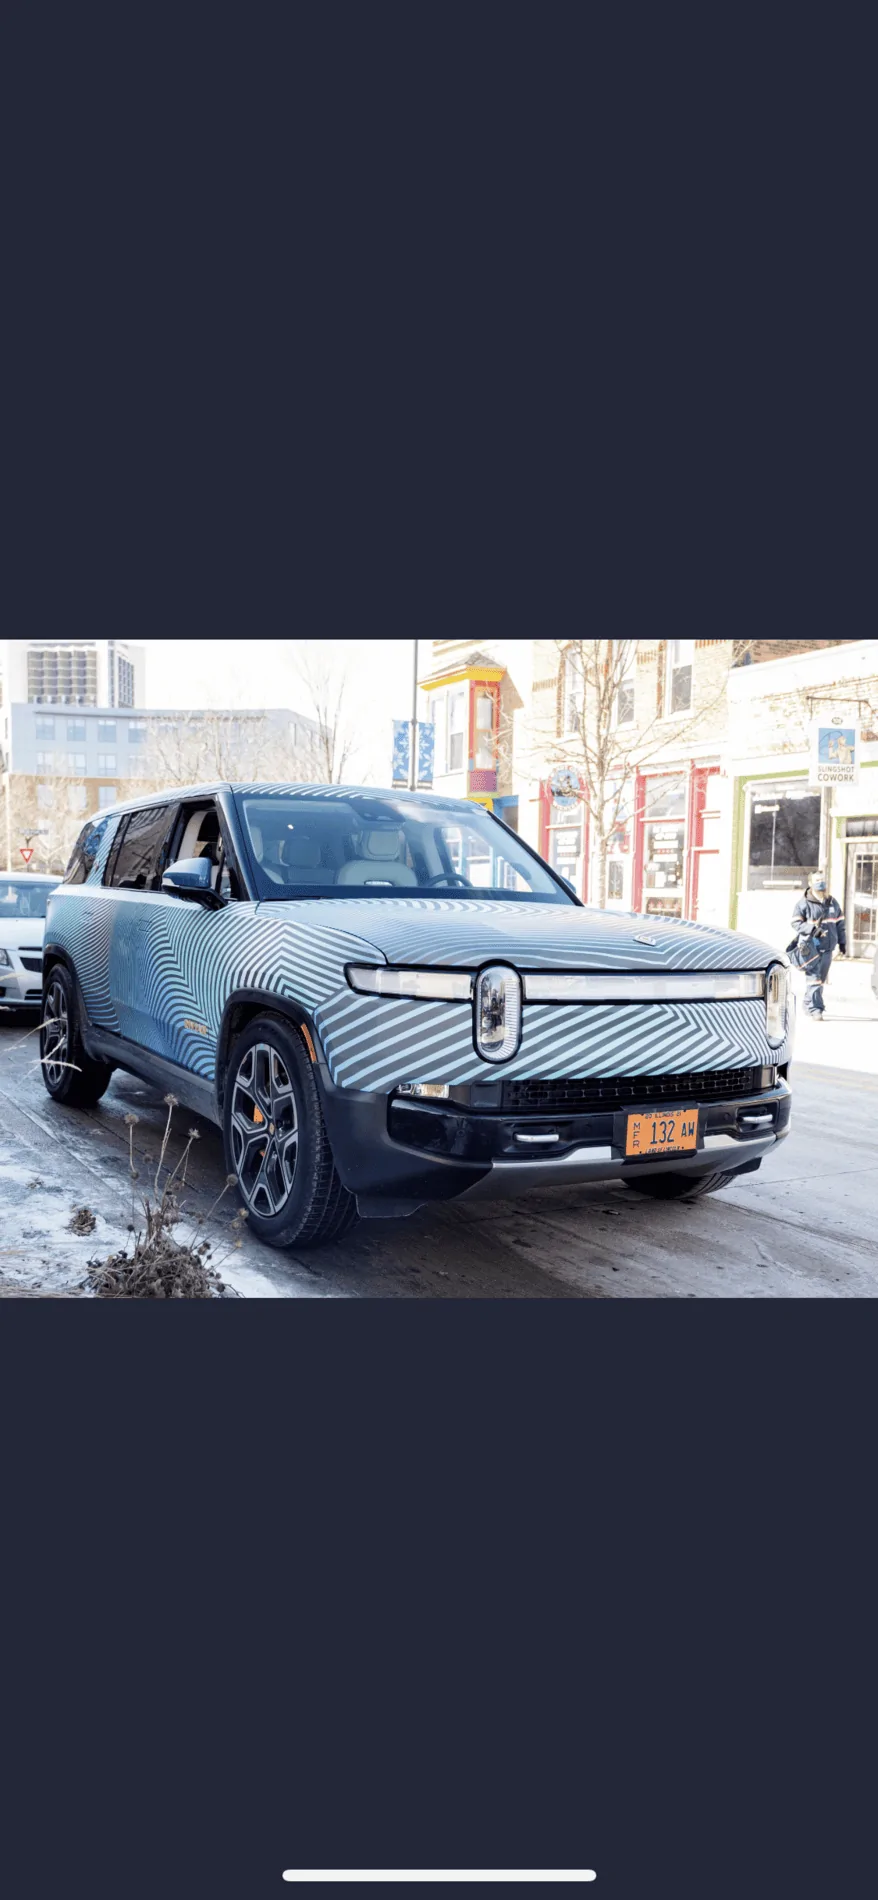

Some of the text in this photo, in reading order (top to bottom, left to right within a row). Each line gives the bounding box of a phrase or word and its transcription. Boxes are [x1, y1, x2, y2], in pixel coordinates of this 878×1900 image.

[817, 773, 854, 782] COWORK
[655, 1111, 674, 1119] ILLINOIS
[650, 1120, 695, 1144] 132 AW
